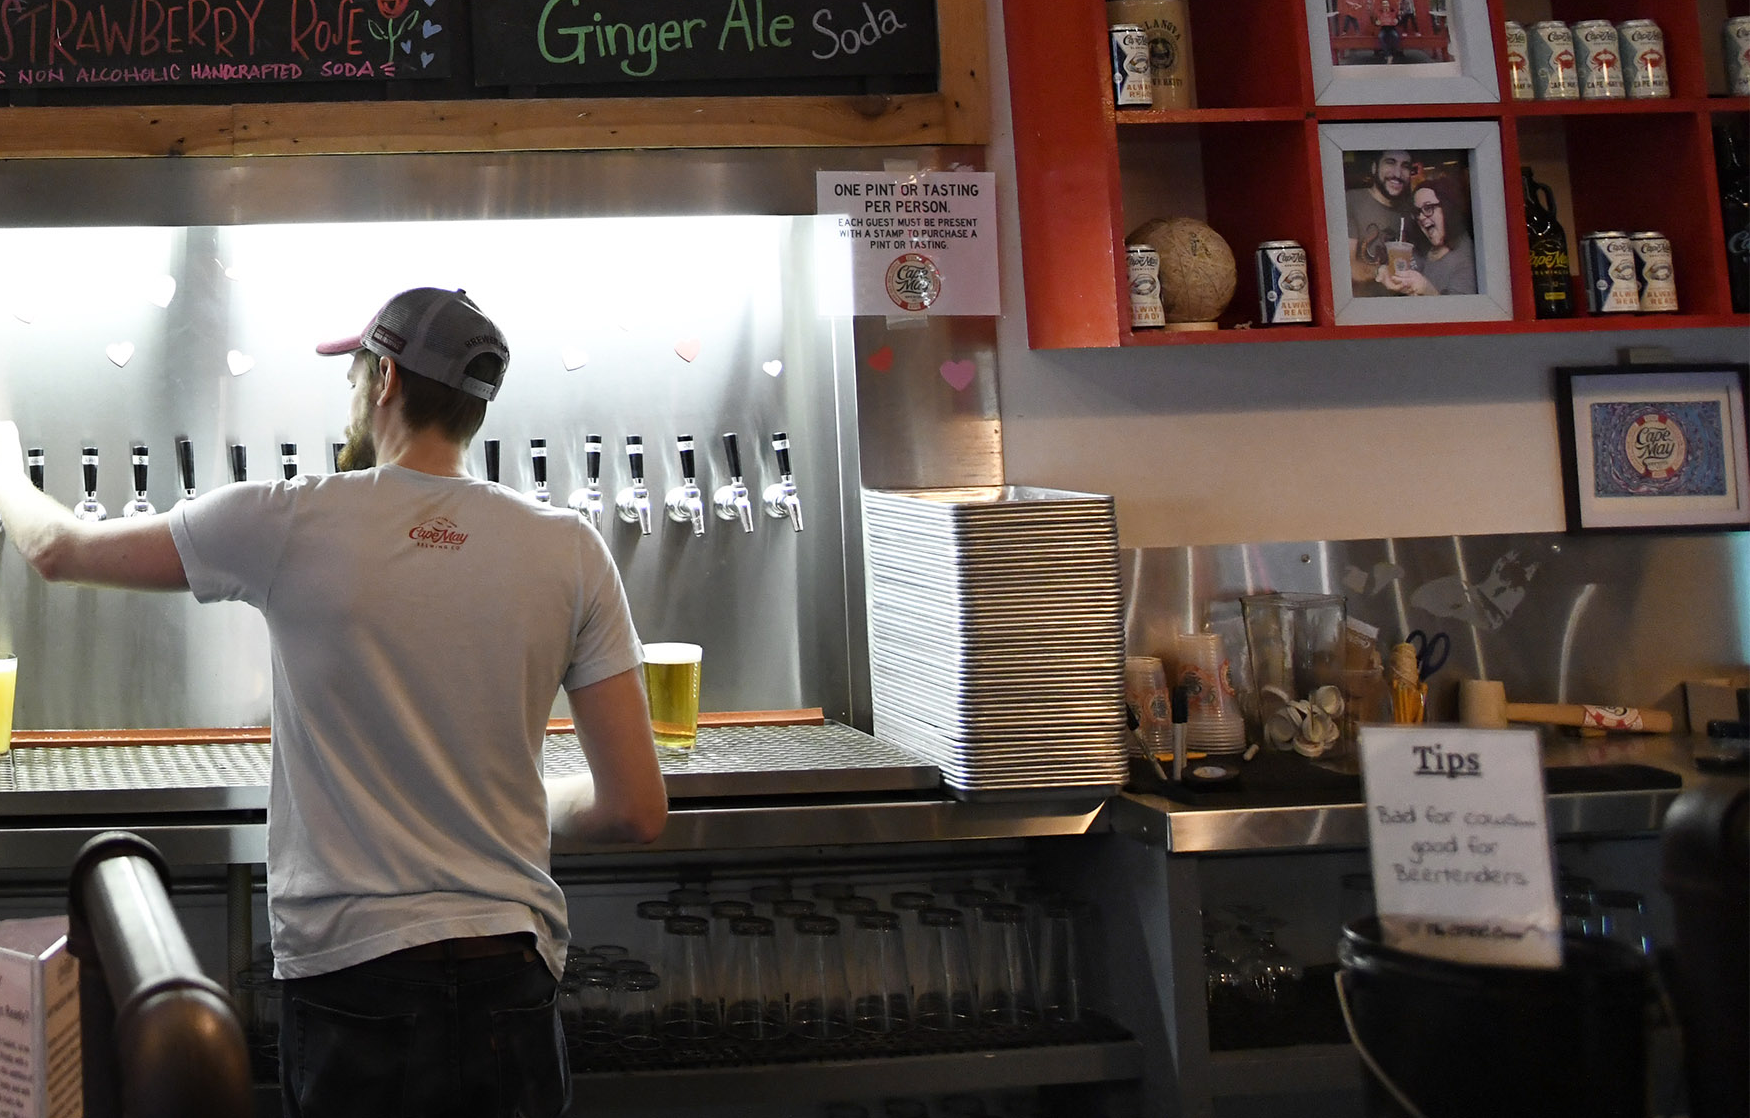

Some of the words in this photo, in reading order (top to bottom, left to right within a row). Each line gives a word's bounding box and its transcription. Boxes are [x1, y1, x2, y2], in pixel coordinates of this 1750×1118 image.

[811, 2, 907, 60] Soda
[17, 69, 64, 84] NON
[77, 64, 181, 83] ALCOHOLIC
[190, 63, 303, 79] HANDCRAFTED
[321, 61, 375, 78] SODA
[1636, 428, 1672, 445] Cape
[1413, 744, 1480, 778] Tips
